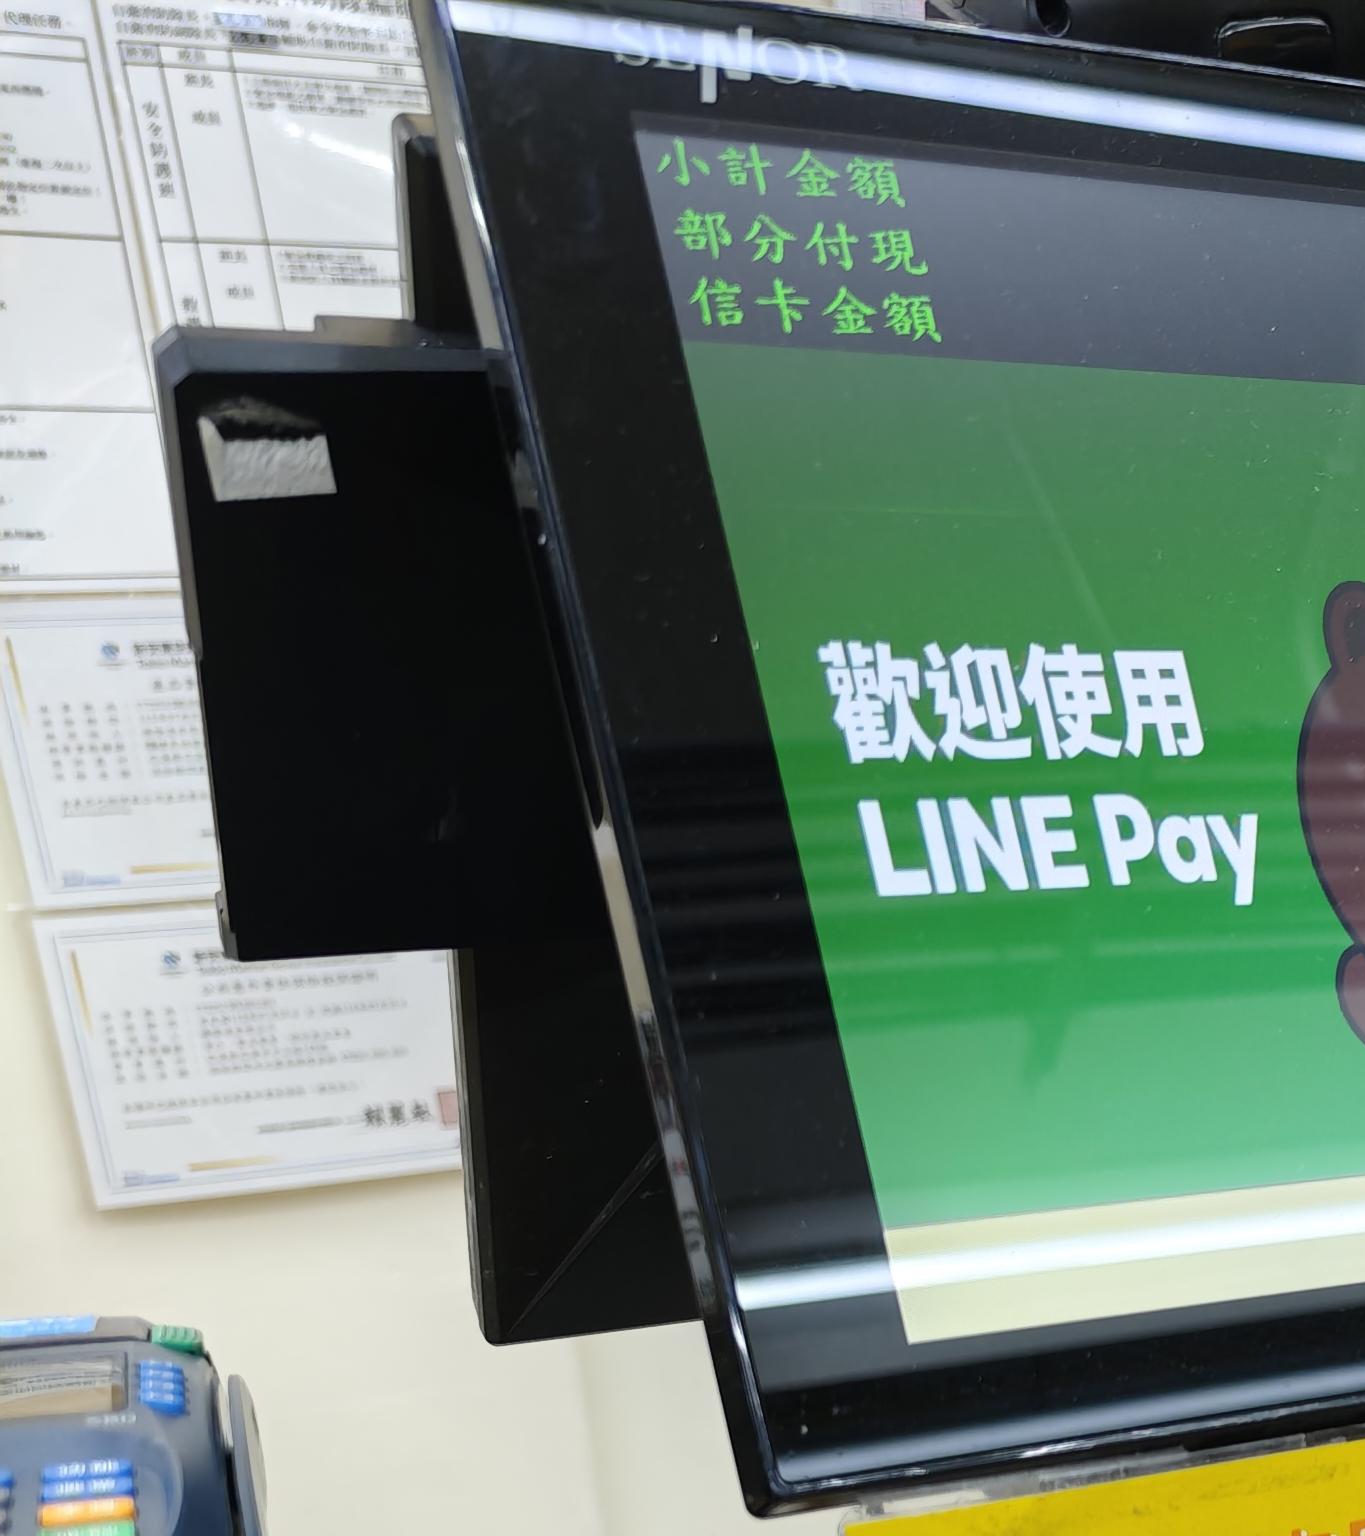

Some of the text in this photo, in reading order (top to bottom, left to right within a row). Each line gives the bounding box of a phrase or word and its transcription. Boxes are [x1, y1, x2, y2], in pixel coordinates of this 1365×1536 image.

[656, 136, 906, 208] 小計金額
[673, 207, 930, 276] 部分付現
[689, 276, 943, 344] 信卡金額
[816, 638, 1206, 764] 歡迎使用
[857, 792, 1259, 906] LINE Pay
